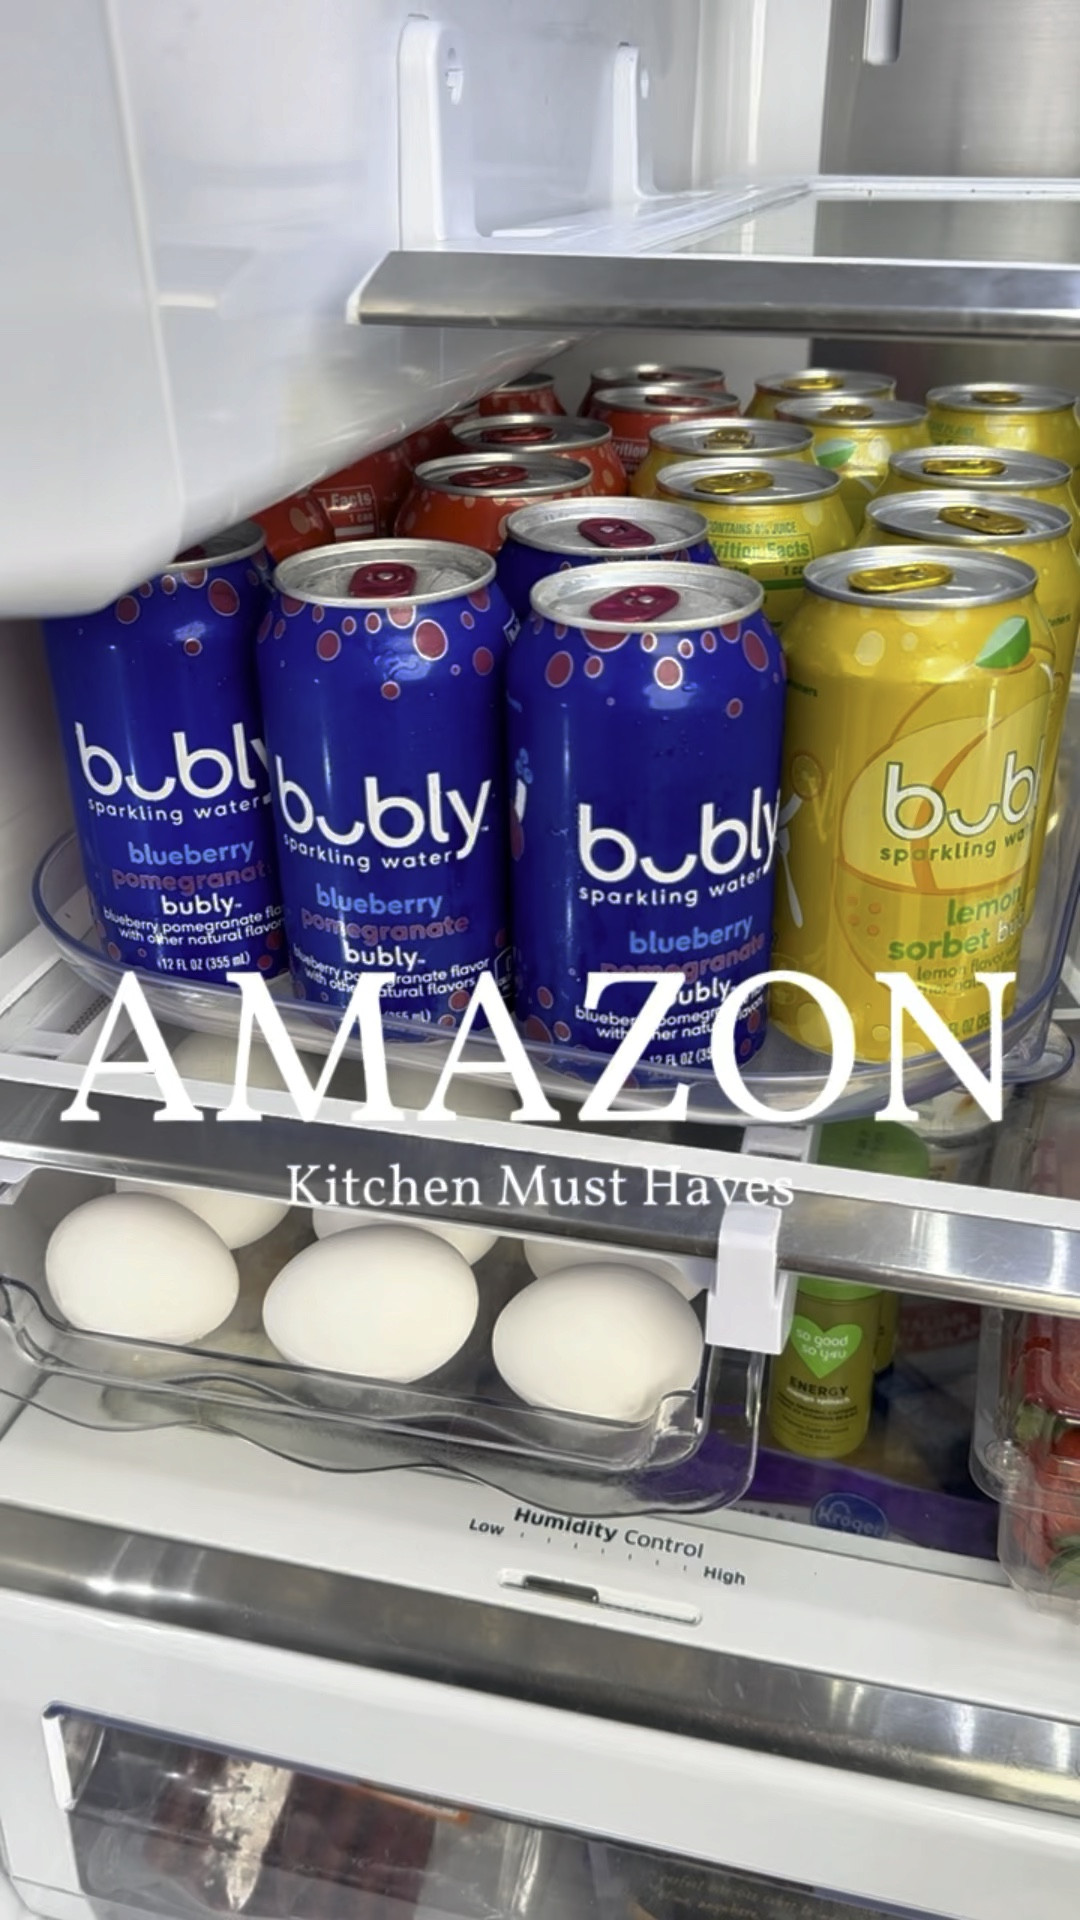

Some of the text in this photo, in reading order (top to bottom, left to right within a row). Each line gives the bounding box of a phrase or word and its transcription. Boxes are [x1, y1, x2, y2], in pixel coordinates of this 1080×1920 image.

[331, 493, 372, 508] Facts
[772, 521, 797, 535] JUICE
[767, 541, 809, 558] Facts
[88, 797, 259, 825] sparkling water
[275, 755, 492, 860] bubly
[578, 786, 780, 884] bubly
[128, 840, 254, 866] blueberry
[284, 834, 452, 873] sparkling water
[880, 838, 996, 866] sparkling
[112, 860, 268, 897] pomegranat
[578, 866, 763, 907] sparkling water
[316, 883, 443, 917] blueberry
[947, 886, 1021, 926] lemon
[103, 905, 158, 934] blueberry
[162, 912, 262, 936] pomegranate
[118, 926, 145, 942] with
[147, 932, 183, 946] other
[188, 927, 243, 946] natural
[302, 907, 469, 946] pomegranate
[629, 915, 753, 954] blueberry
[888, 928, 990, 961] sorbet
[176, 958, 188, 971] FL
[190, 957, 203, 971] OZ
[205, 954, 231, 972] (355
[293, 943, 340, 981] blueberry
[450, 957, 490, 978] flavor
[304, 966, 328, 987] with
[380, 984, 424, 998] atural
[427, 976, 475, 996] flavors
[678, 976, 731, 1004] ubly
[665, 1053, 677, 1067] FL
[680, 1051, 694, 1065] OZ
[814, 1335, 848, 1349] good
[790, 1376, 849, 1397] ENERGY
[469, 1518, 504, 1536] Low
[513, 1507, 705, 1560] Humidity Control
[818, 1504, 883, 1536] Kroger
[703, 1566, 746, 1586] High
